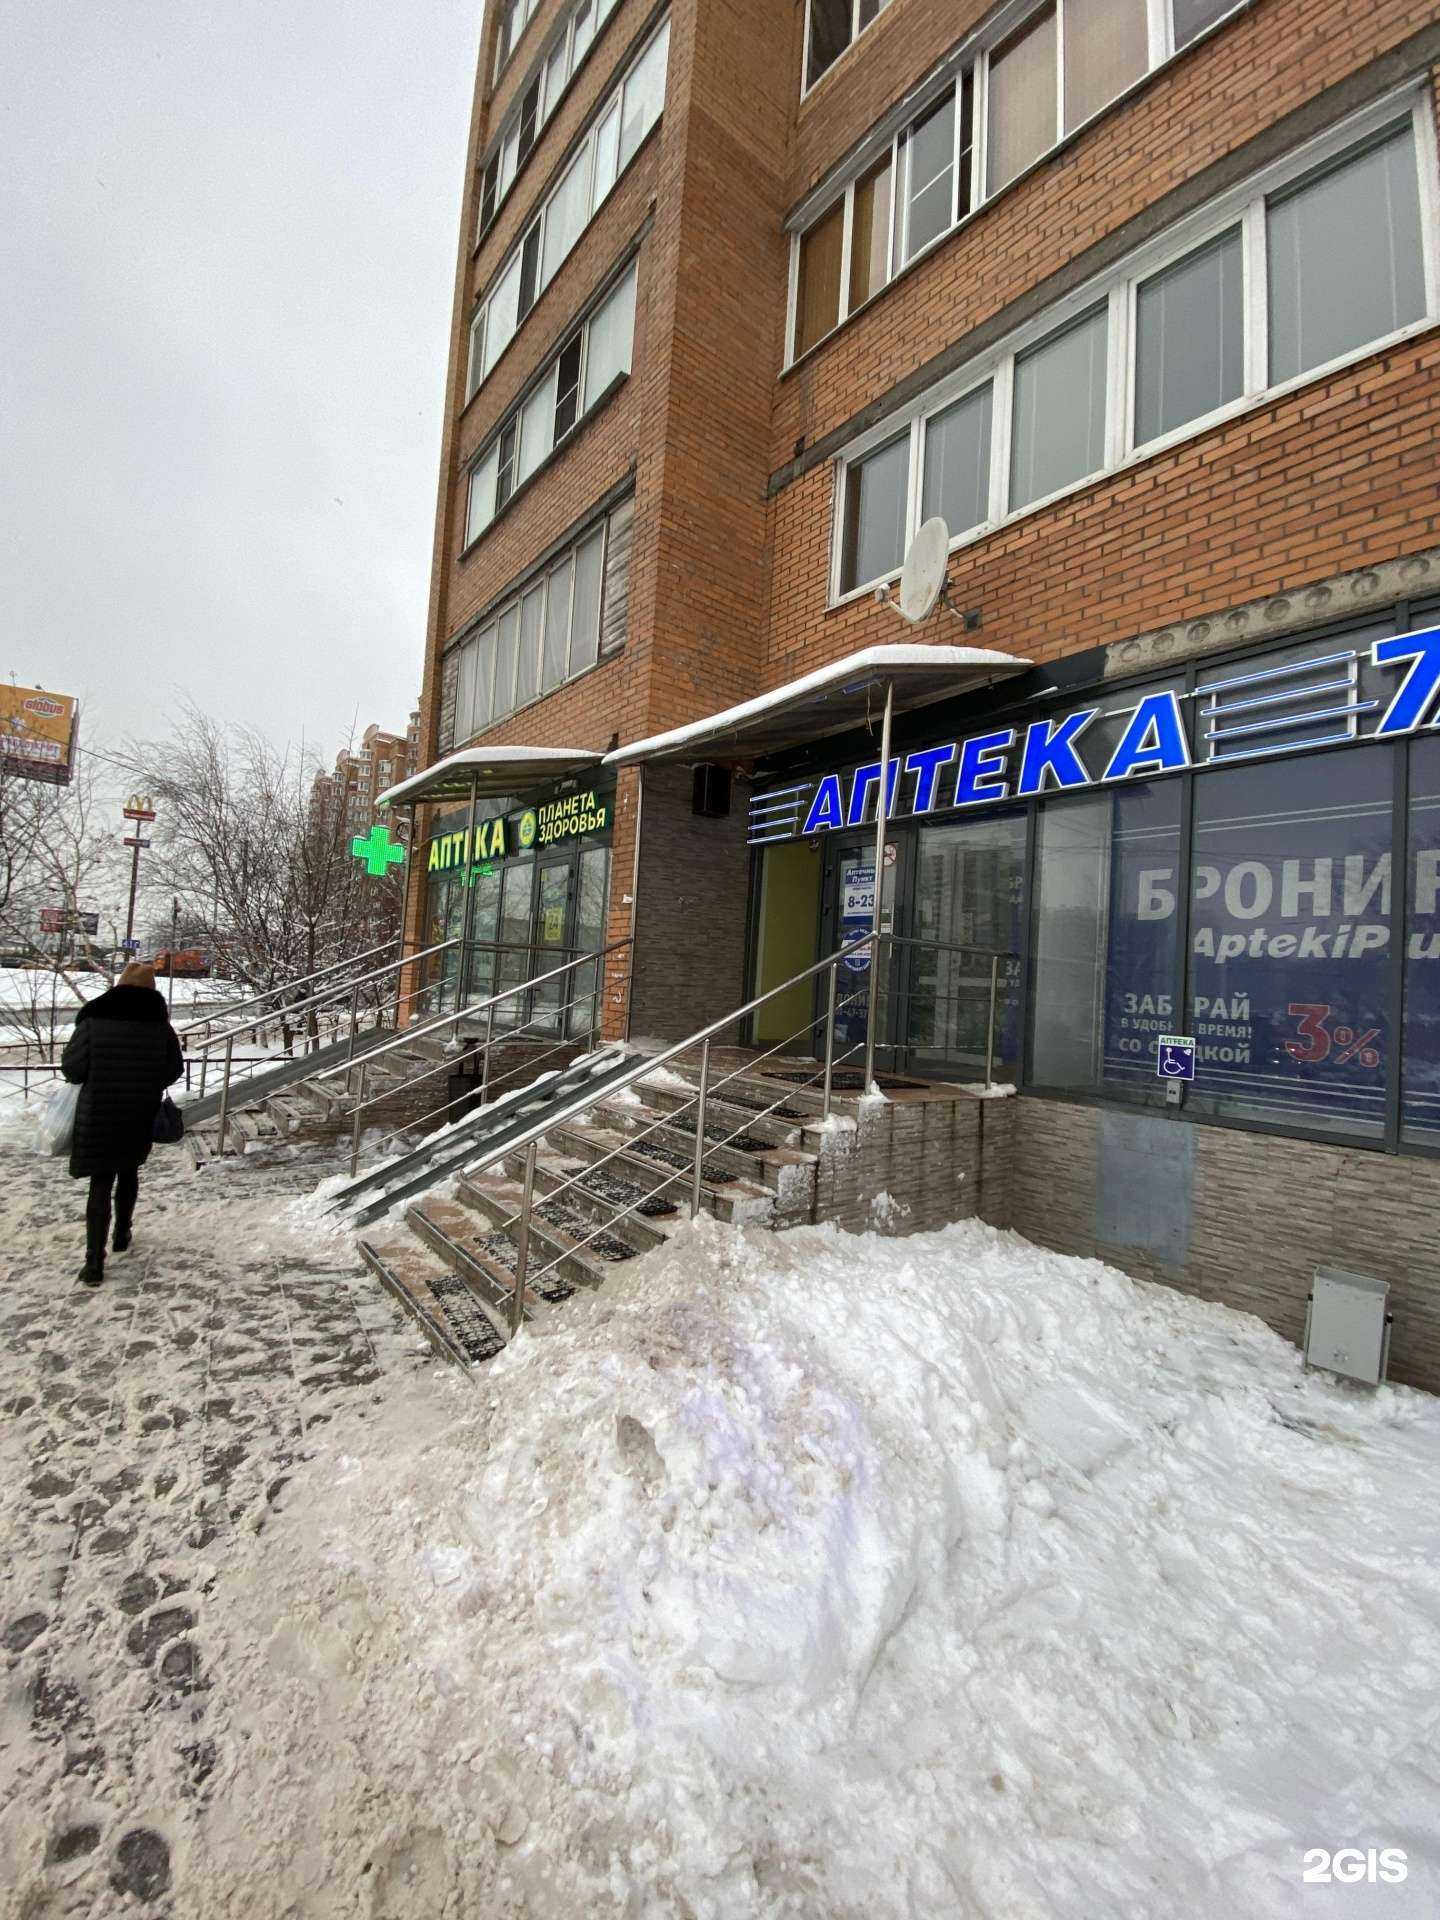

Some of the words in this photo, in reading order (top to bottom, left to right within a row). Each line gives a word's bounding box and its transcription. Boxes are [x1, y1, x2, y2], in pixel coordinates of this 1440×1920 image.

[801, 688, 1192, 834] АПТЕКА
[538, 791, 596, 825] ПЛАНЕТА
[538, 807, 606, 844] ЗДОРОВЬЯ
[847, 894, 875, 908] 8-23
[1124, 991, 1250, 1021] ЗАБРАЙ
[1119, 1038, 1142, 1053] СО
[1160, 1037, 1195, 1046] АПТЕКА
[1198, 1023, 1252, 1039] ВРЕМЯ!
[1285, 1003, 1382, 1068] 3%
